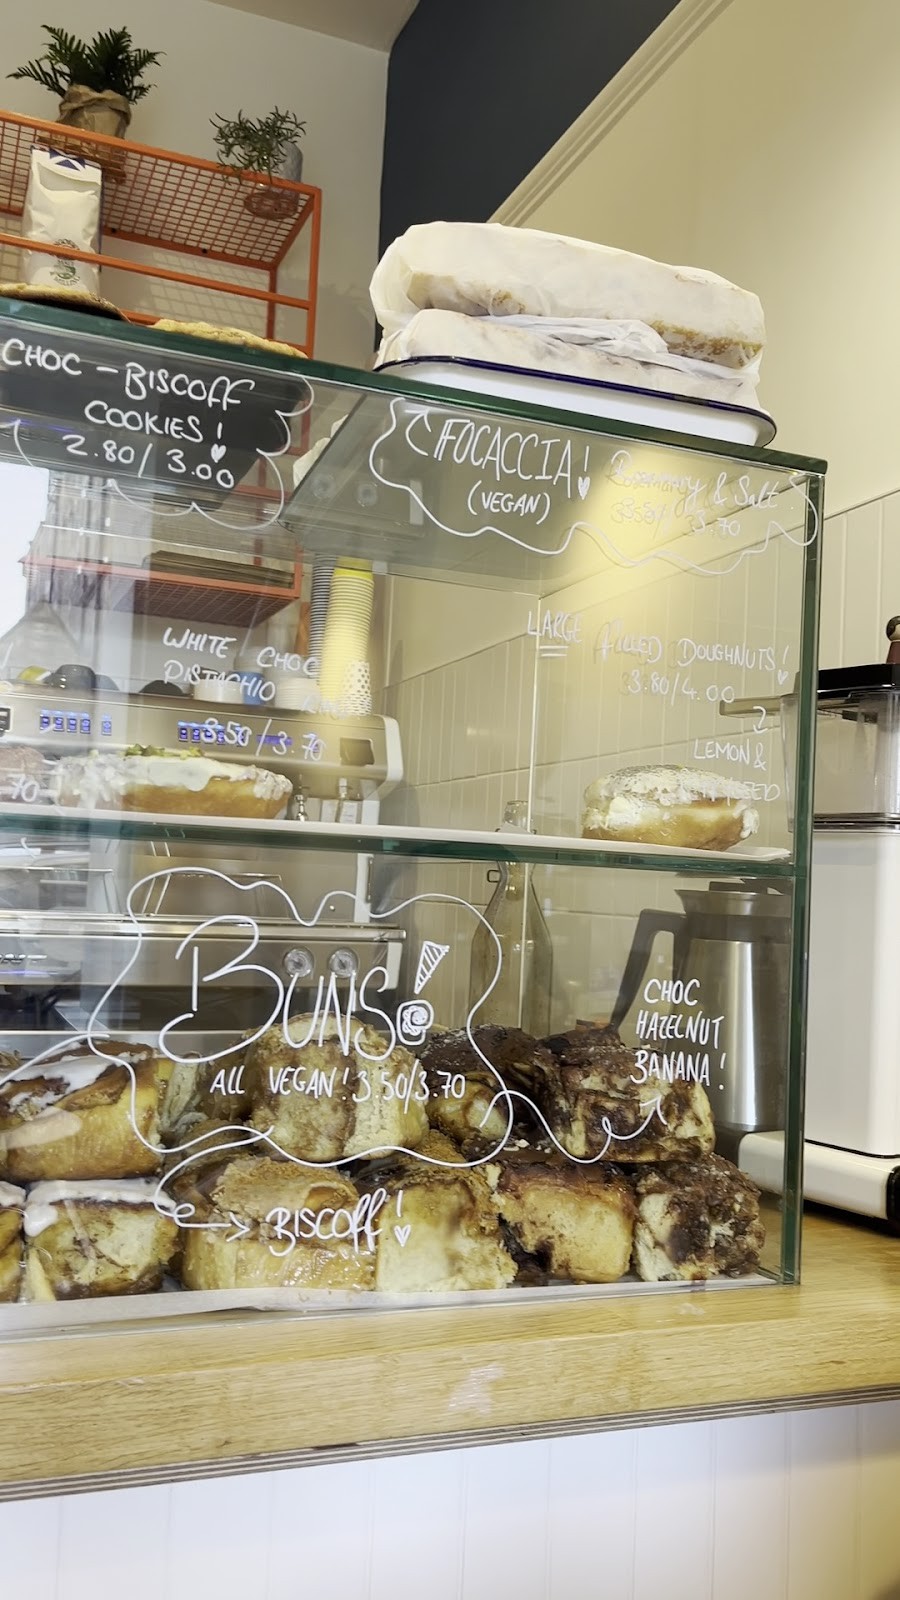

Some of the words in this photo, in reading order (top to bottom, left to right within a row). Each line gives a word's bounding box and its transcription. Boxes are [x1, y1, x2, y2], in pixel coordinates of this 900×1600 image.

[1, 338, 82, 376] CHOC
[433, 418, 590, 499] FOCACCIA!
[468, 479, 551, 525] (VEGAN)
[734, 475, 780, 508] Salt
[527, 610, 582, 643] LARGE
[163, 627, 237, 658] WHITE
[256, 647, 320, 676] CHOC
[694, 739, 750, 766] LEMON
[753, 742, 767, 771] &
[644, 978, 700, 1006] CHOC
[636, 1009, 724, 1049] HAZELNUT
[210, 1069, 245, 1097] ALL
[269, 1066, 350, 1101] VEGAN!
